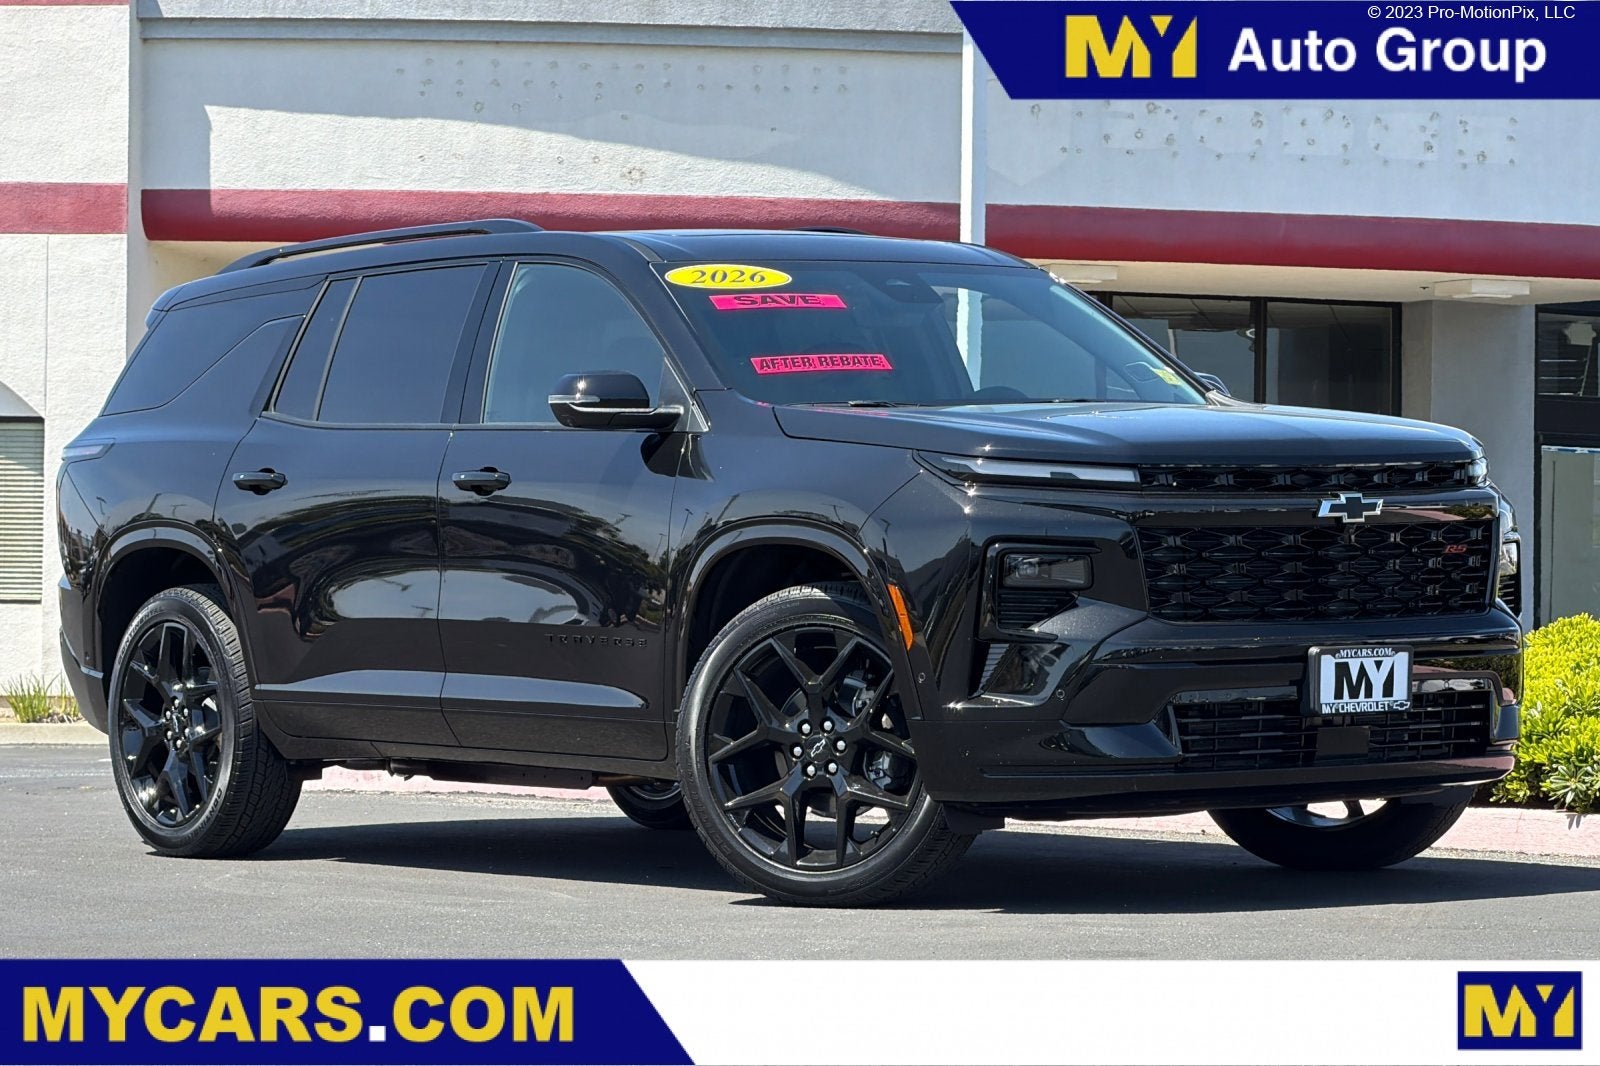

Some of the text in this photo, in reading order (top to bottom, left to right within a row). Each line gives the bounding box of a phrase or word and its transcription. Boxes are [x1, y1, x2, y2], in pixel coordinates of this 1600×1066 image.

[690, 269, 767, 284] 2026
[733, 295, 824, 306] SAVE
[759, 355, 881, 370] AFTER REBATE
[1445, 544, 1467, 554] RS
[1339, 647, 1393, 658] MYCARS.COM
[1333, 660, 1395, 701] MY
[1321, 701, 1389, 714] MY CHEVROLET
